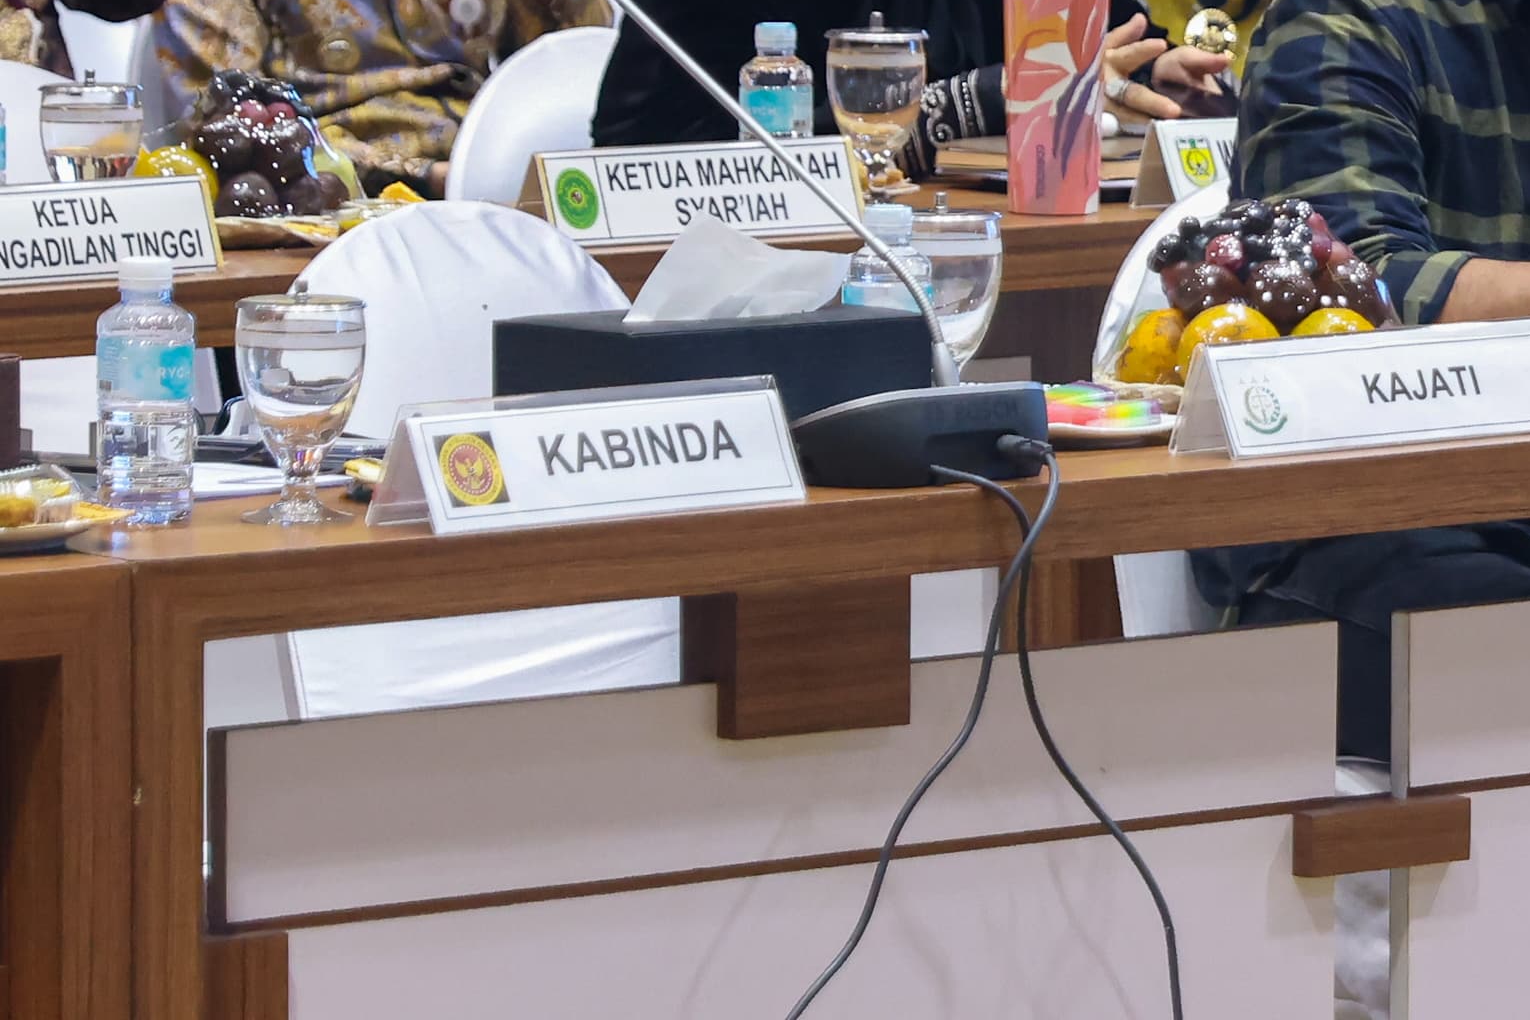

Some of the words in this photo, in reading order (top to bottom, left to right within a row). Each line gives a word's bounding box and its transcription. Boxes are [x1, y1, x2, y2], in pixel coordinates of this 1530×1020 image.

[605, 160, 693, 192] KETUA
[32, 197, 118, 228] KETUA
[122, 228, 204, 259] TINGGI
[1361, 365, 1481, 404] KAJATI
[538, 419, 742, 476] KABINDA
